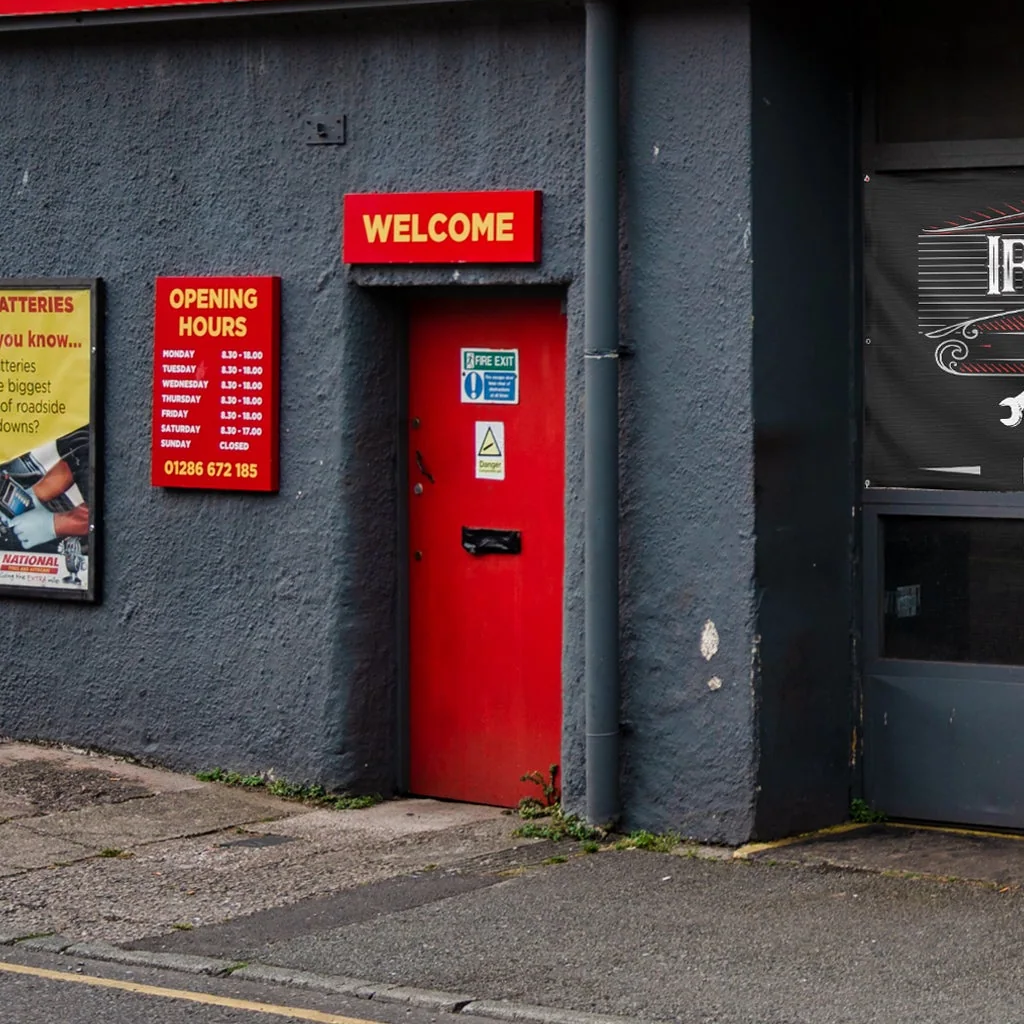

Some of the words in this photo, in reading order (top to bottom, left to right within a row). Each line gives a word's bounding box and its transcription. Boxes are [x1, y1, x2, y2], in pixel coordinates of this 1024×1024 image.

[362, 212, 514, 243] WELCOME
[0, 296, 74, 313] ATTERIES
[169, 288, 258, 309] OPENING
[178, 316, 247, 337] HOURS
[28, 330, 82, 348] know...
[162, 350, 195, 358] MONDAY
[0, 358, 36, 373] tteries
[475, 355, 493, 366] FIRE
[494, 356, 514, 367] EXIT
[162, 364, 196, 373] TUESDAY
[8, 378, 51, 396] biggest
[162, 379, 208, 388] WEDNESDAY
[162, 394, 201, 404] THURSDAY
[16, 400, 66, 414] roadside
[162, 410, 188, 418] FRIDAY
[161, 424, 200, 433] SATURDAY
[161, 439, 191, 448] SUNDAY
[220, 441, 249, 450] CLOSED
[164, 460, 203, 476] 01286
[207, 462, 232, 477] 672
[235, 463, 257, 478] 185
[2, 554, 59, 567] NATIONAL
